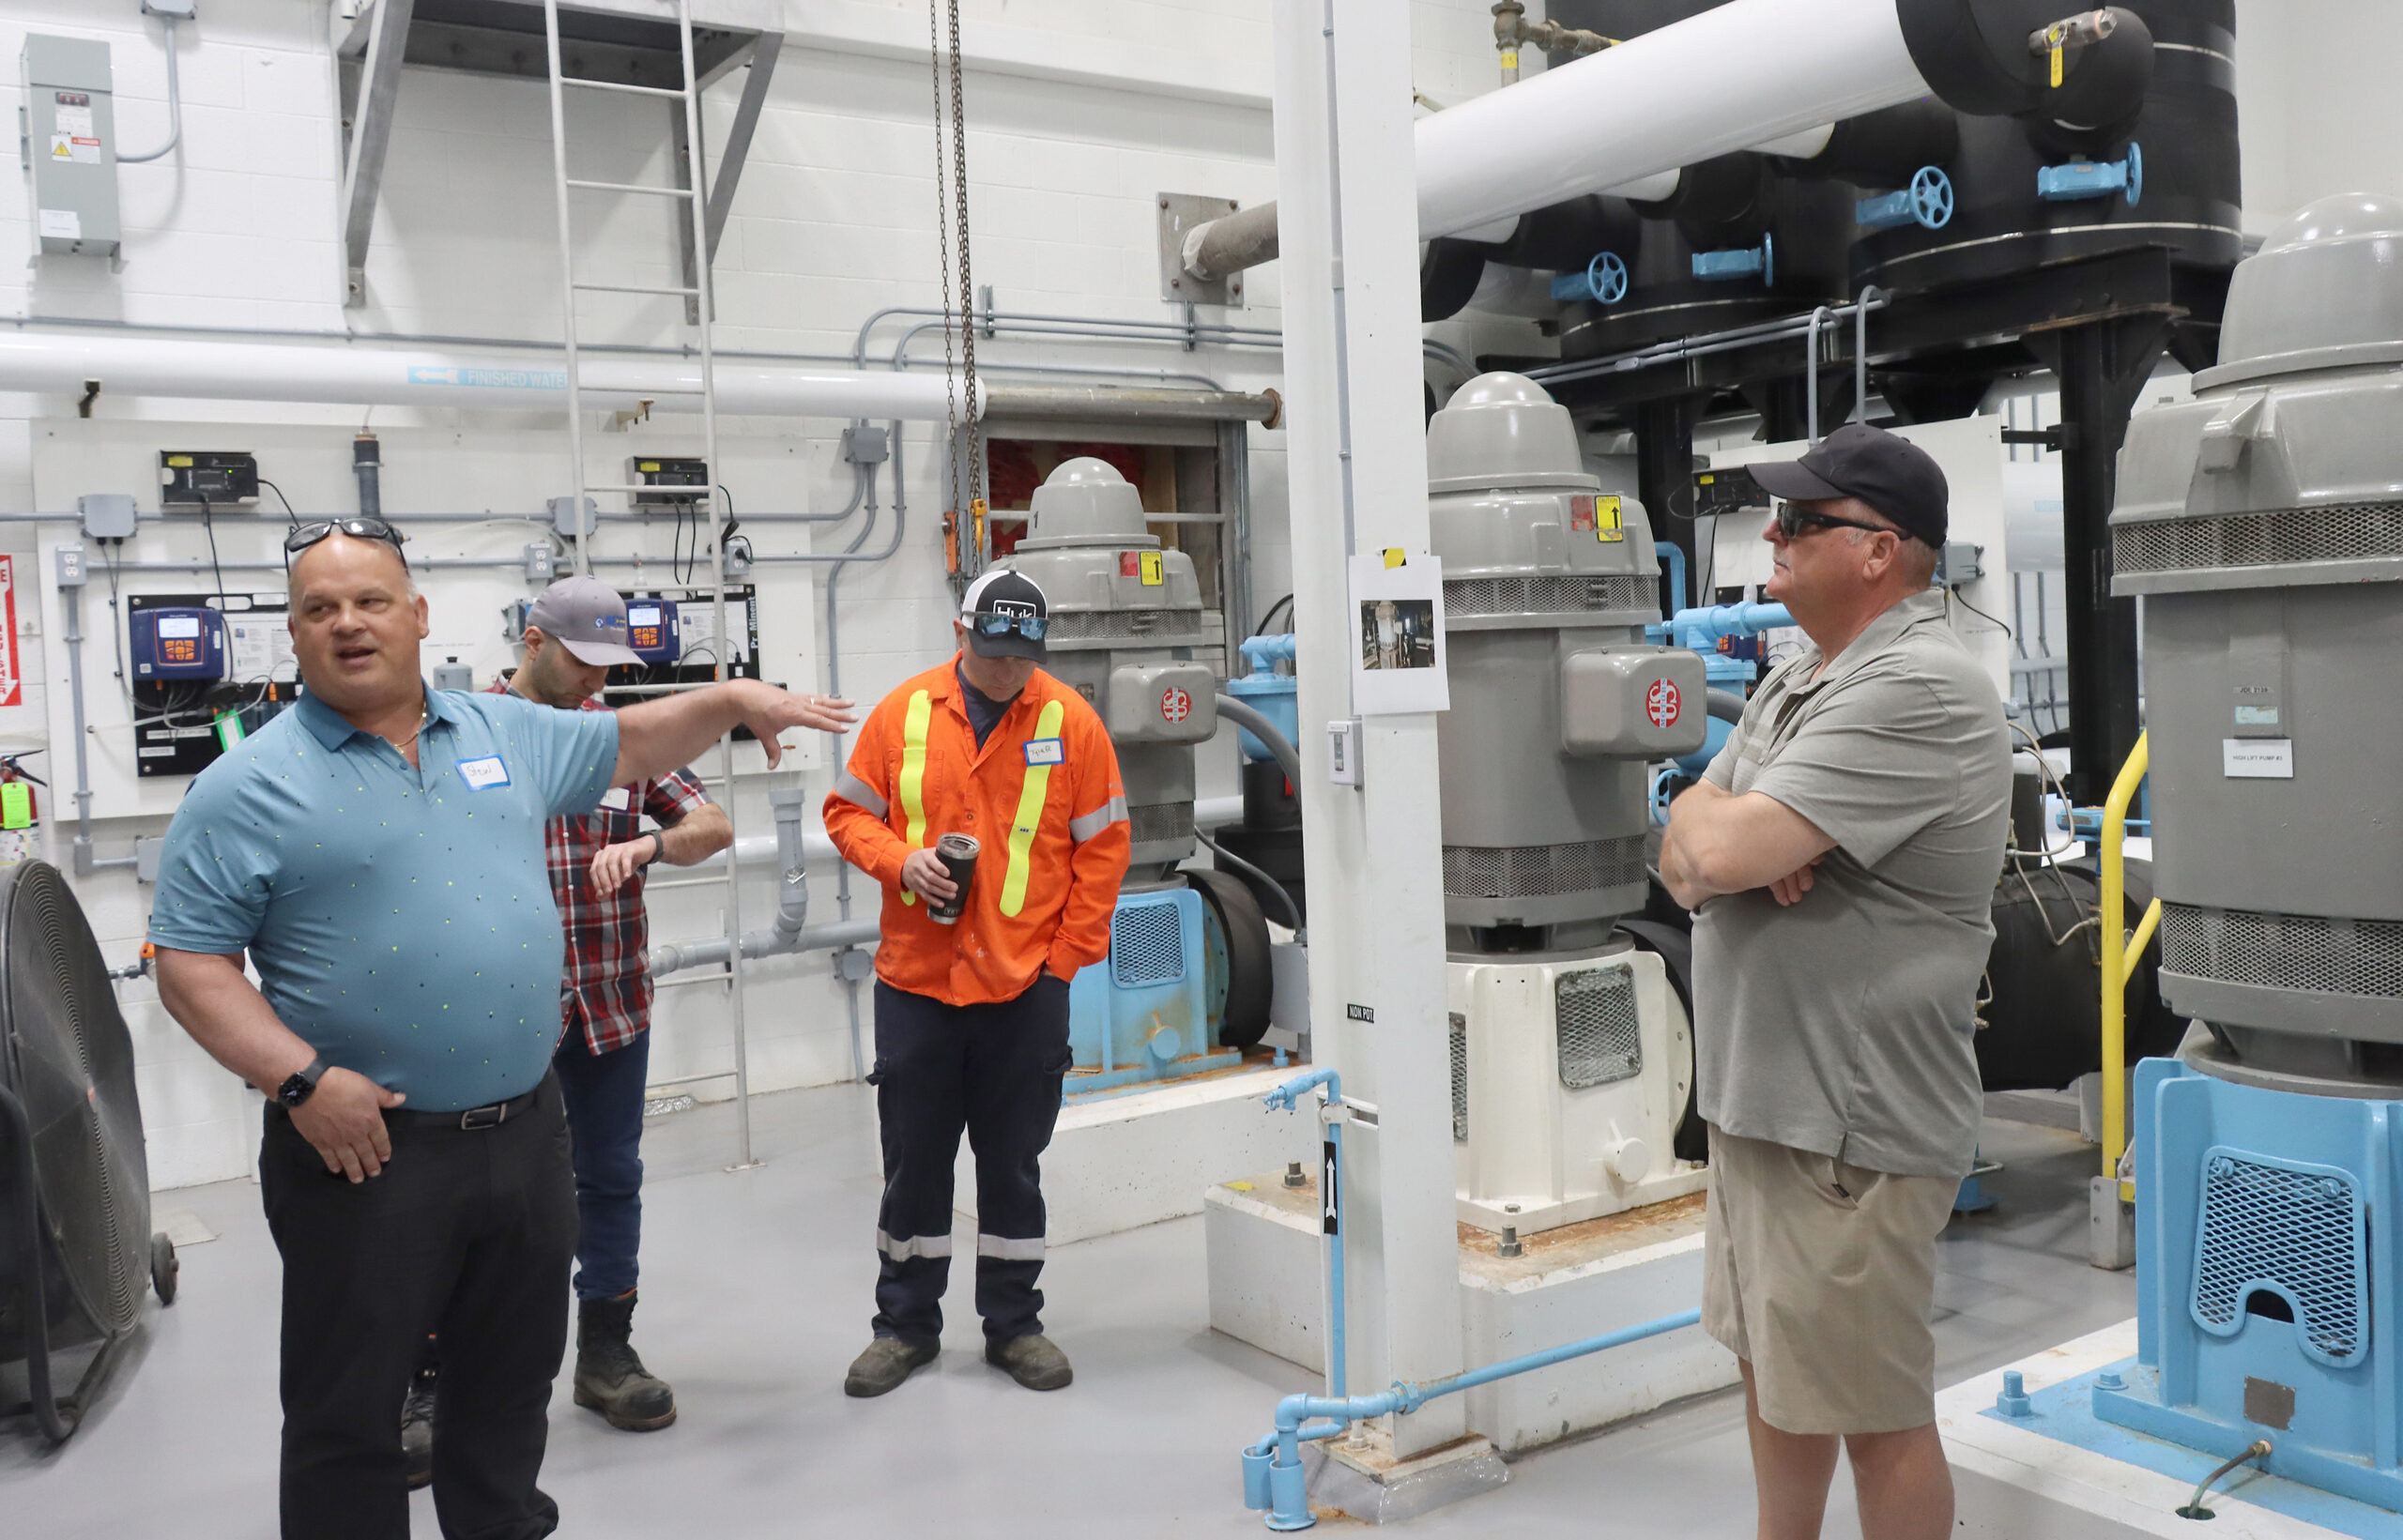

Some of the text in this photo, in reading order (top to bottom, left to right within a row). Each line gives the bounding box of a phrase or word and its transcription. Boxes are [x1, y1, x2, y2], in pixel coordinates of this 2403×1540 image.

[467, 370, 526, 387] FINISHED
[1033, 511, 1039, 528] 1
[1349, 1005, 1362, 1018] NON
